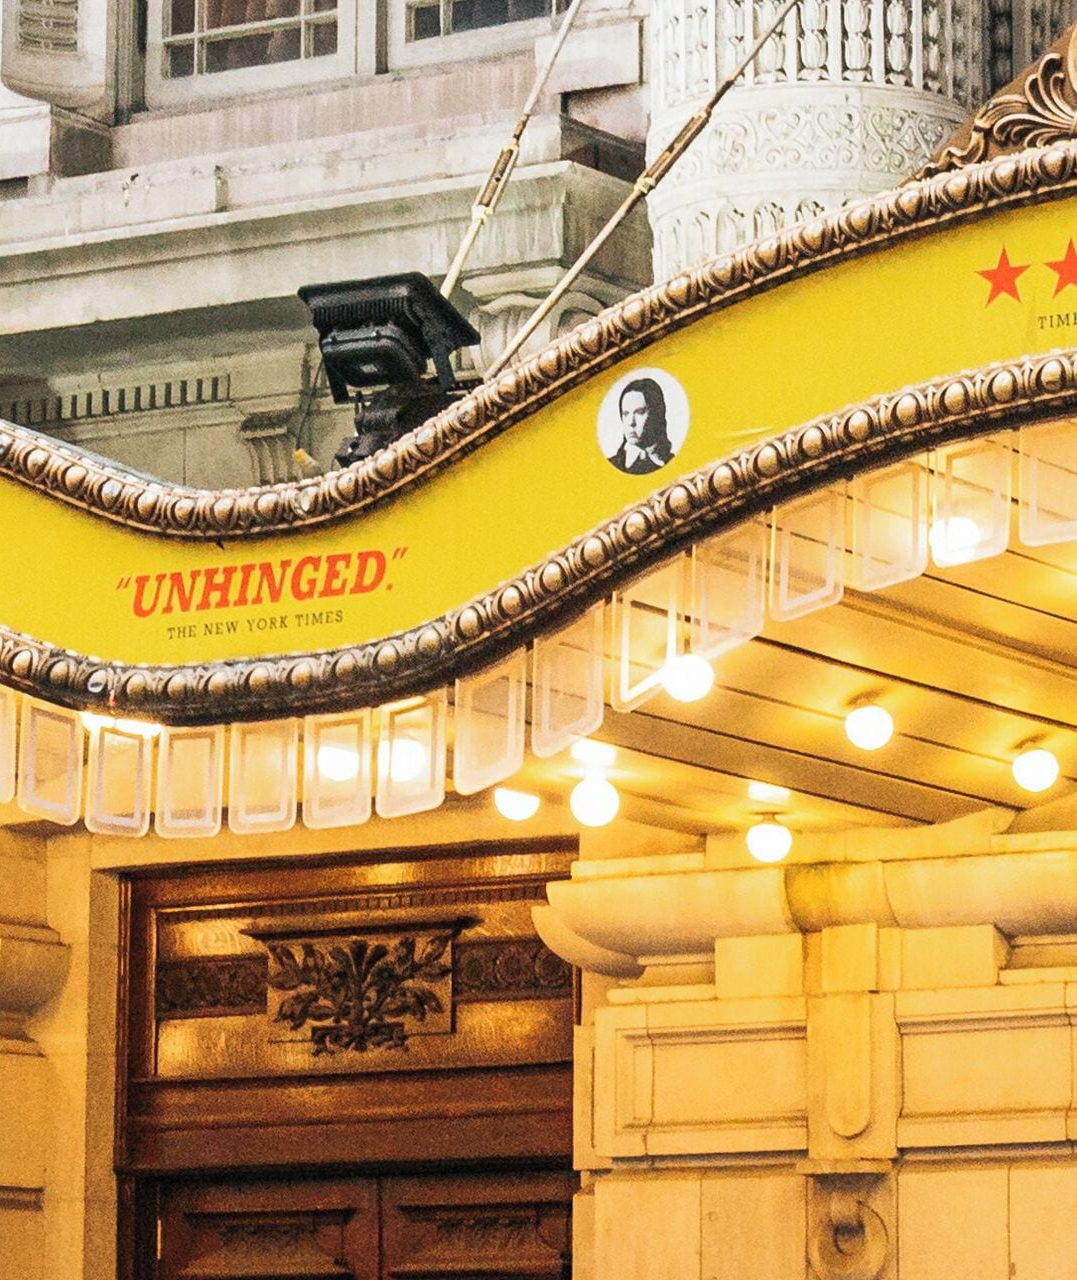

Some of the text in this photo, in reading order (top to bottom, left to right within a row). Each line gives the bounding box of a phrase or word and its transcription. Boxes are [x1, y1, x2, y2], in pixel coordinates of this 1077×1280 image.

[115, 546, 409, 618] "UNHINGED."
[167, 610, 344, 640] THE NEW YORK TIMES
